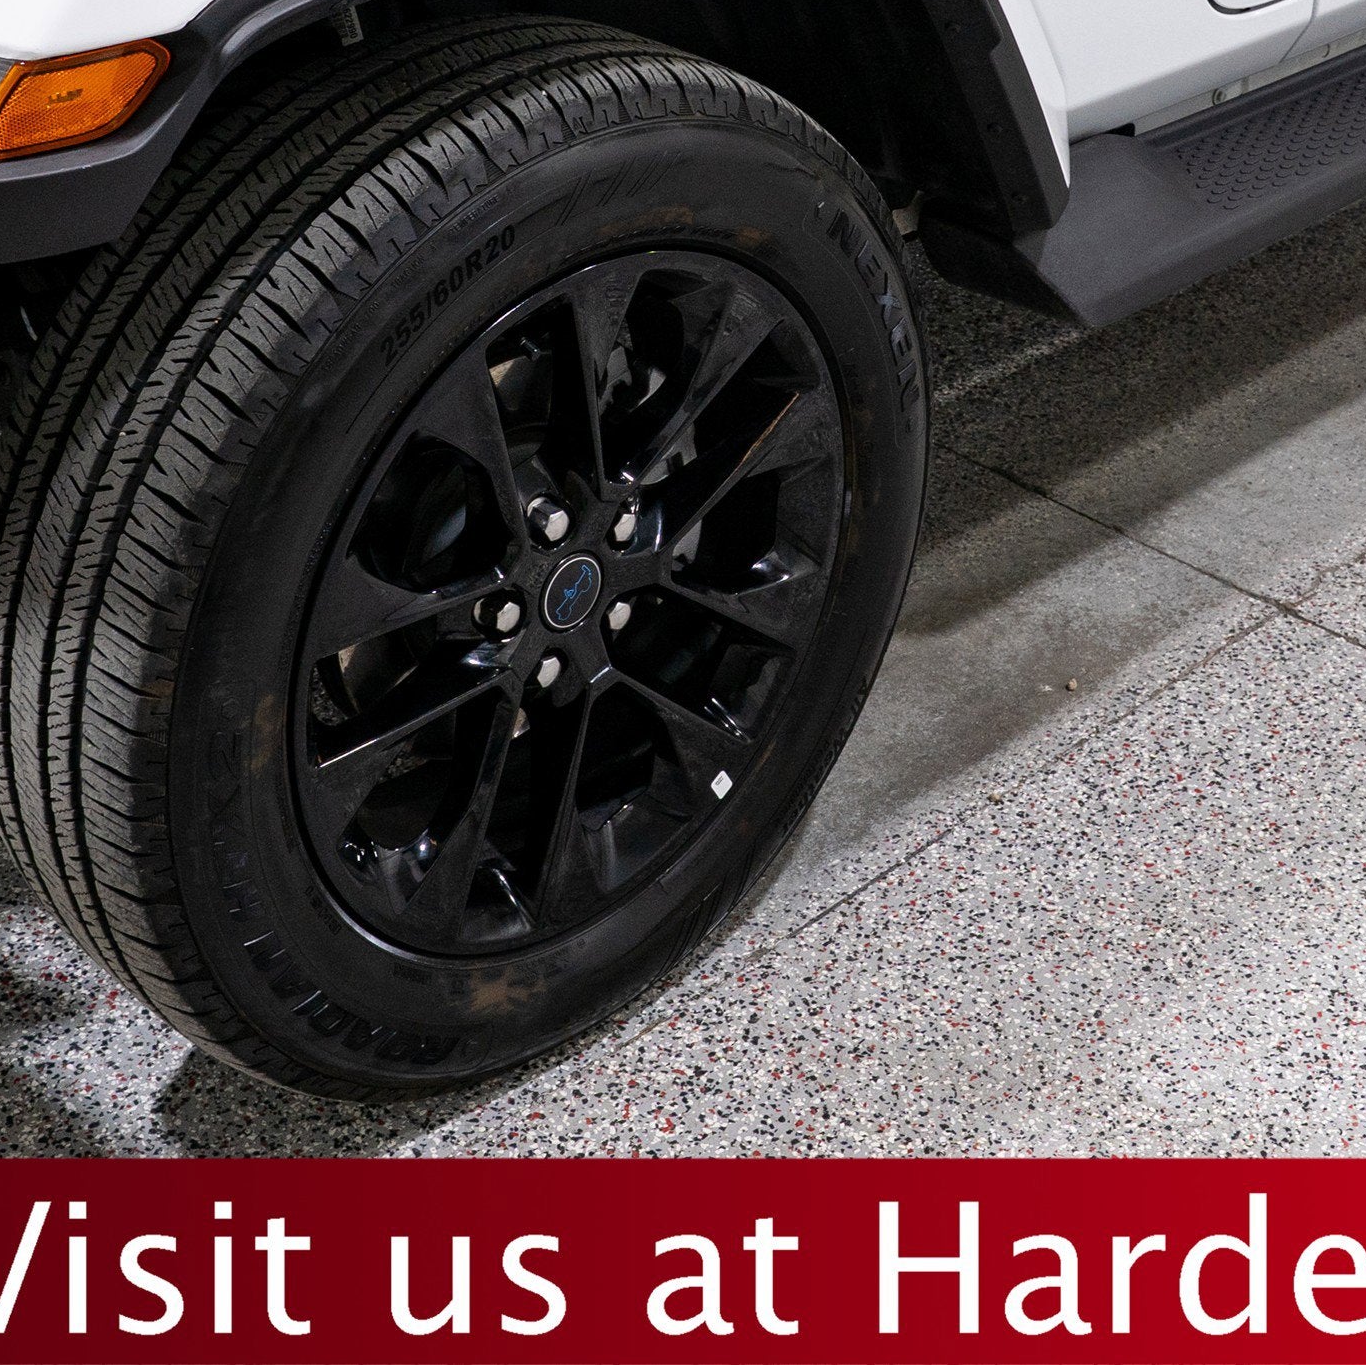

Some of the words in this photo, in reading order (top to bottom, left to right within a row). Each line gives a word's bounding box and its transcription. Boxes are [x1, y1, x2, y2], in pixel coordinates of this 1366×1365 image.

[381, 224, 517, 365] 255/60R20
[825, 208, 920, 412] NEXEN
[242, 930, 461, 1066] ROADIAN
